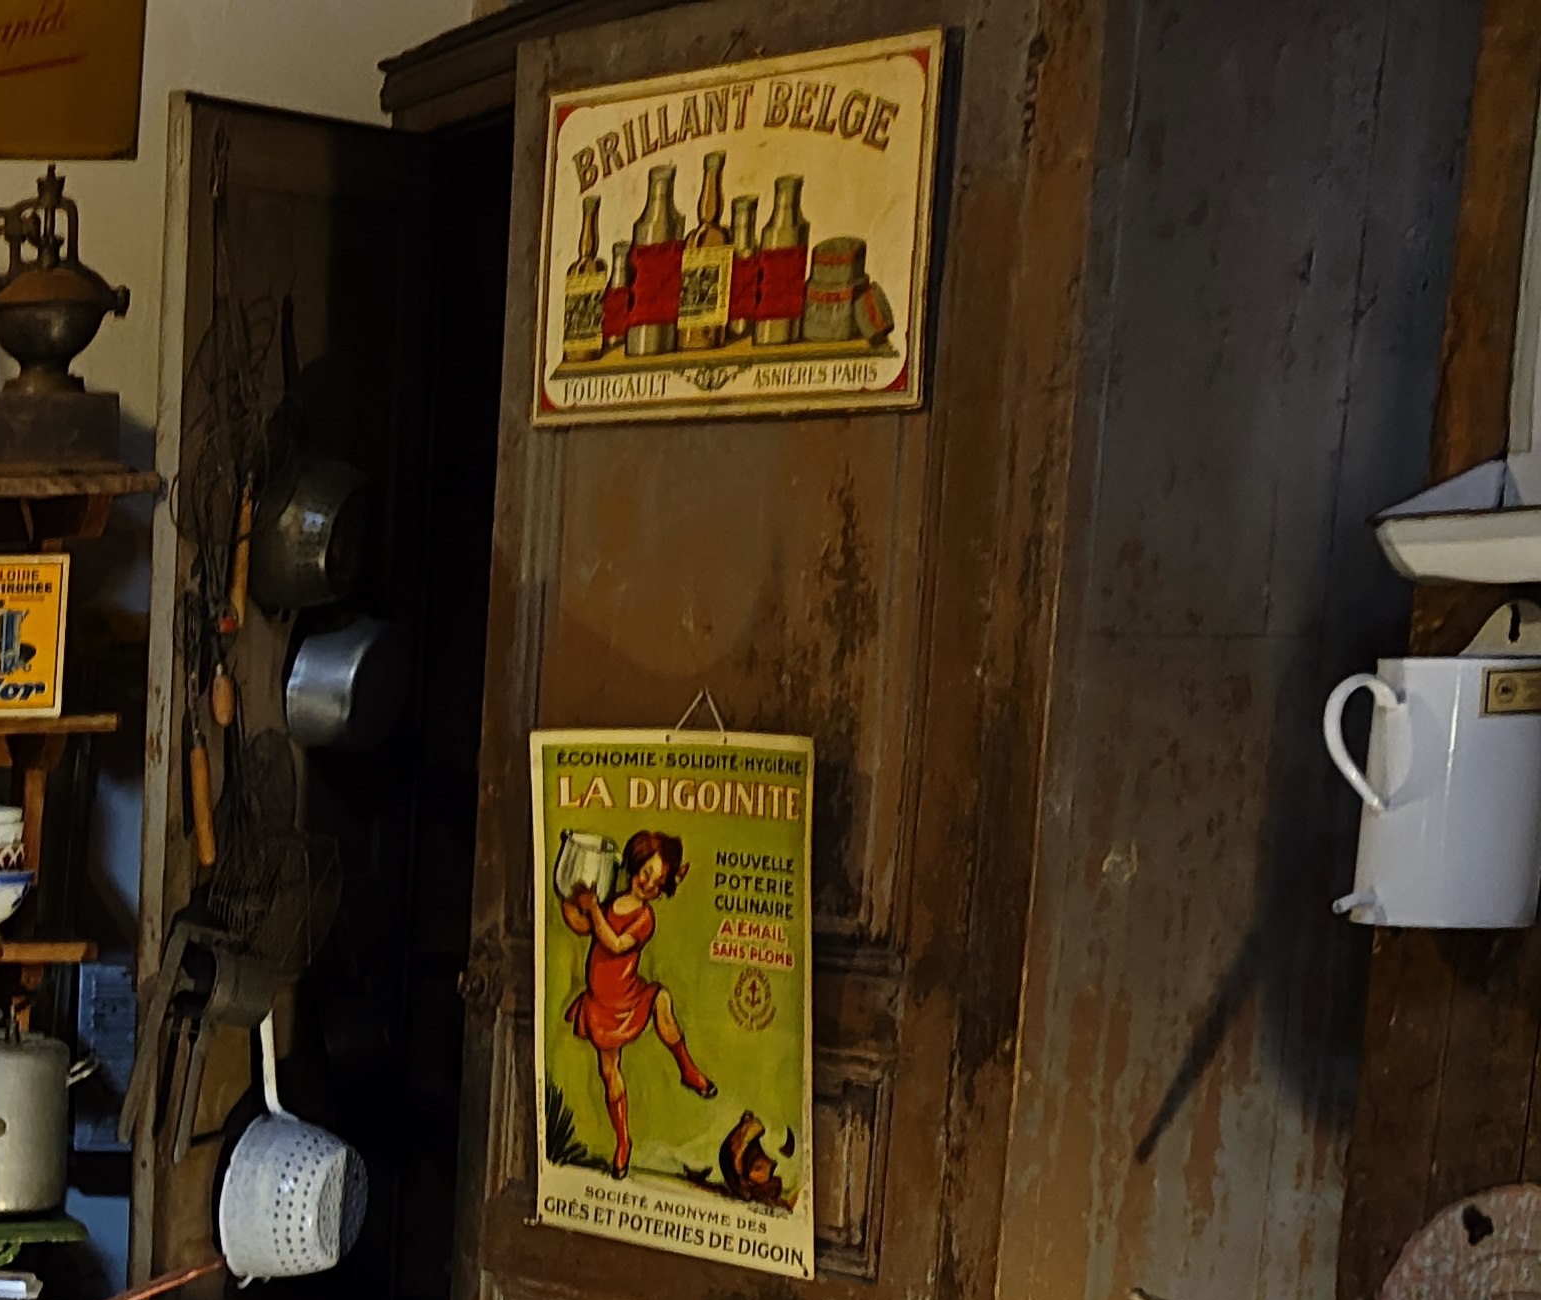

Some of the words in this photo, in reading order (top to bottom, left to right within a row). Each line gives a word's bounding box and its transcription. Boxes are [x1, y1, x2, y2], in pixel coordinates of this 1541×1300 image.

[572, 82, 755, 195] BRILLANT
[763, 80, 901, 152] BELGE
[831, 362, 879, 386] PARIS
[557, 749, 658, 768] ÉCONOMIE
[666, 751, 740, 771] SOLIDITÉ
[557, 775, 614, 809] LA
[628, 776, 802, 822] DIGOINITE
[716, 850, 796, 874] NOUVELLE
[714, 873, 795, 897] POTERIE
[714, 896, 795, 920] CULINAIRE
[711, 942, 747, 960] SANS
[749, 945, 795, 968] PLOMB
[584, 1185, 648, 1211] SOCIÉTÉ
[653, 1199, 731, 1228] ANONYME
[736, 1215, 768, 1235] DES
[593, 1205, 616, 1228] ET
[618, 1211, 706, 1247] POTERIES
[708, 1232, 735, 1253] DE
[737, 1237, 805, 1268] DIGOIN
